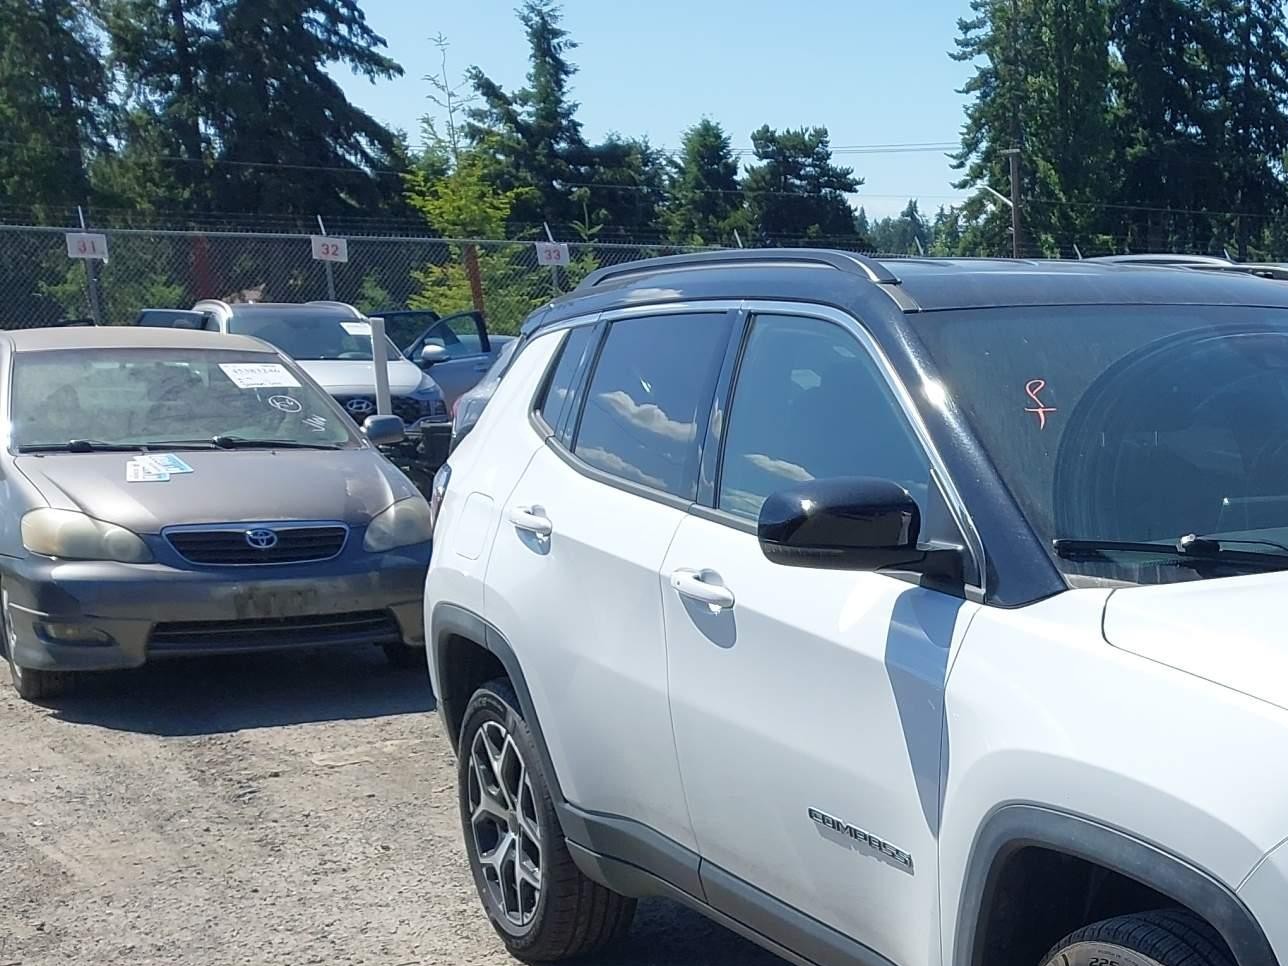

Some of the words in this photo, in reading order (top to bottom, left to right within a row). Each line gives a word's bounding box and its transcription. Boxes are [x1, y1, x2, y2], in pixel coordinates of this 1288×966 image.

[78, 239, 96, 254] 31
[321, 243, 339, 256] 32
[544, 249, 560, 260] 33
[807, 806, 913, 868] COMPASS
